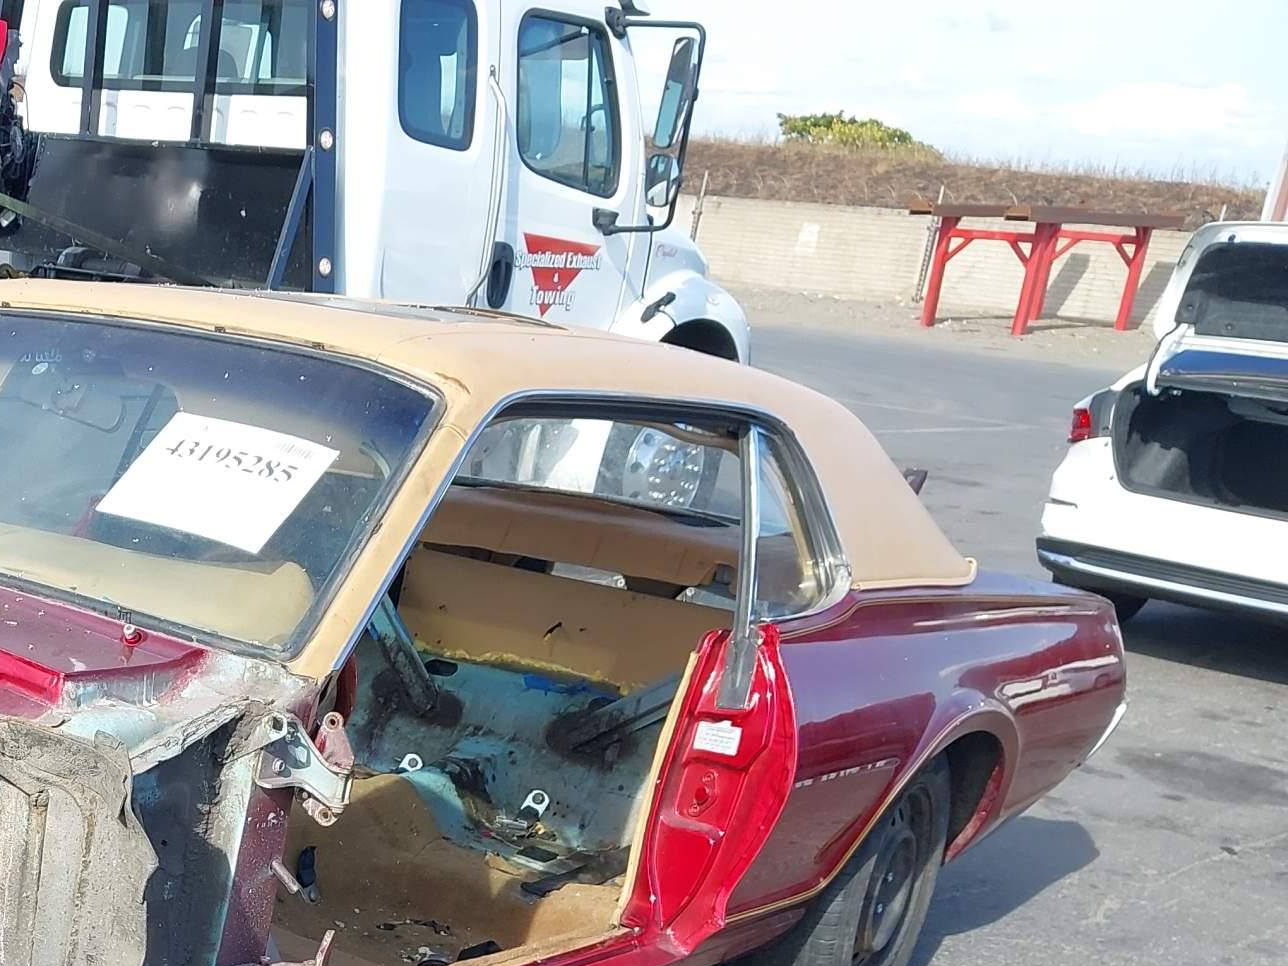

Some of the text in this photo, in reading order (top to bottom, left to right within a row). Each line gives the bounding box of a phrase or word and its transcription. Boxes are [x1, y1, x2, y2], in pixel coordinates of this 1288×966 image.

[514, 250, 602, 270] Specialized Exhaust
[529, 285, 575, 311] Towing
[165, 439, 299, 482] 43195285
